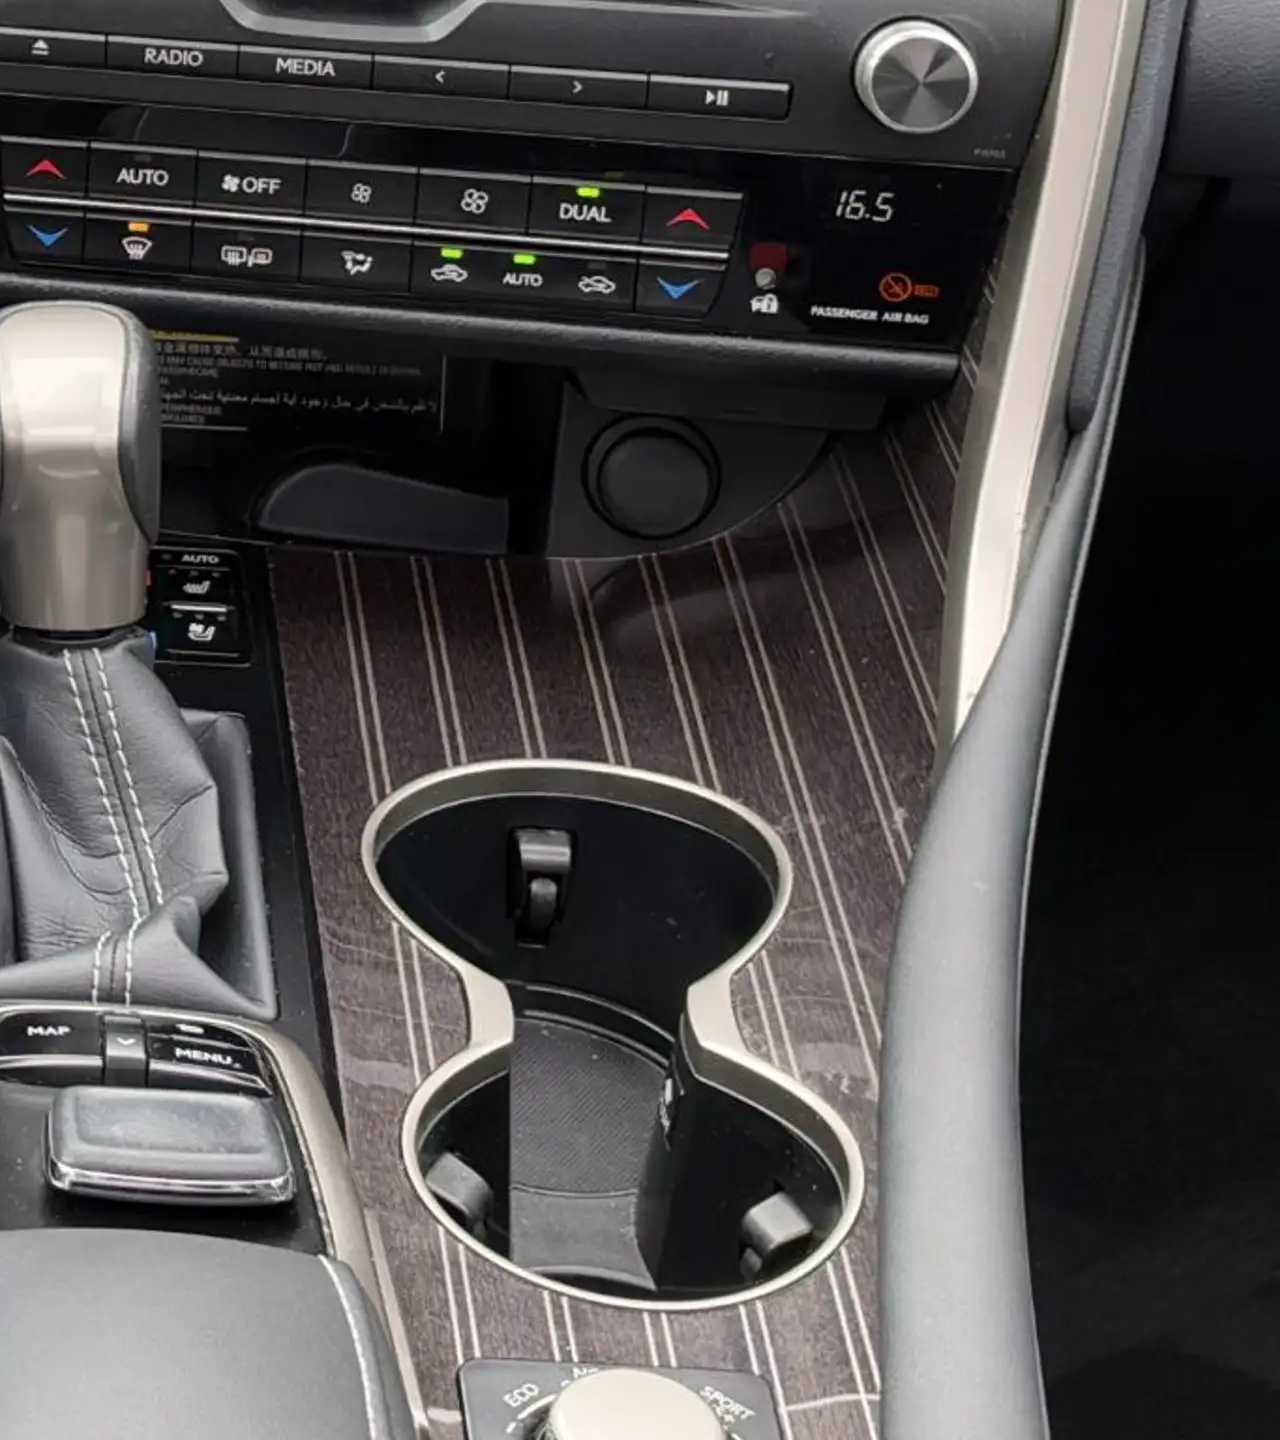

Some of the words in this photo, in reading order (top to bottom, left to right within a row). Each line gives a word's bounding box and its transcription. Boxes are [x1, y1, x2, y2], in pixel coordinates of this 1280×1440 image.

[144, 48, 204, 68] RADIO
[275, 57, 337, 79] MEDIA
[116, 167, 170, 187] AUTO
[241, 176, 282, 196] OFF
[559, 203, 612, 224] DUAL
[834, 189, 896, 223] 16.5
[502, 271, 543, 288] AUTO
[810, 304, 879, 321] PASSENGER
[882, 310, 903, 324] AIR
[903, 312, 930, 326] BAG
[181, 554, 220, 564] AUTO
[27, 1024, 71, 1037] MAP
[175, 1046, 233, 1066] MENU
[503, 1382, 540, 1413] ECO
[699, 1386, 757, 1421] SPORT
